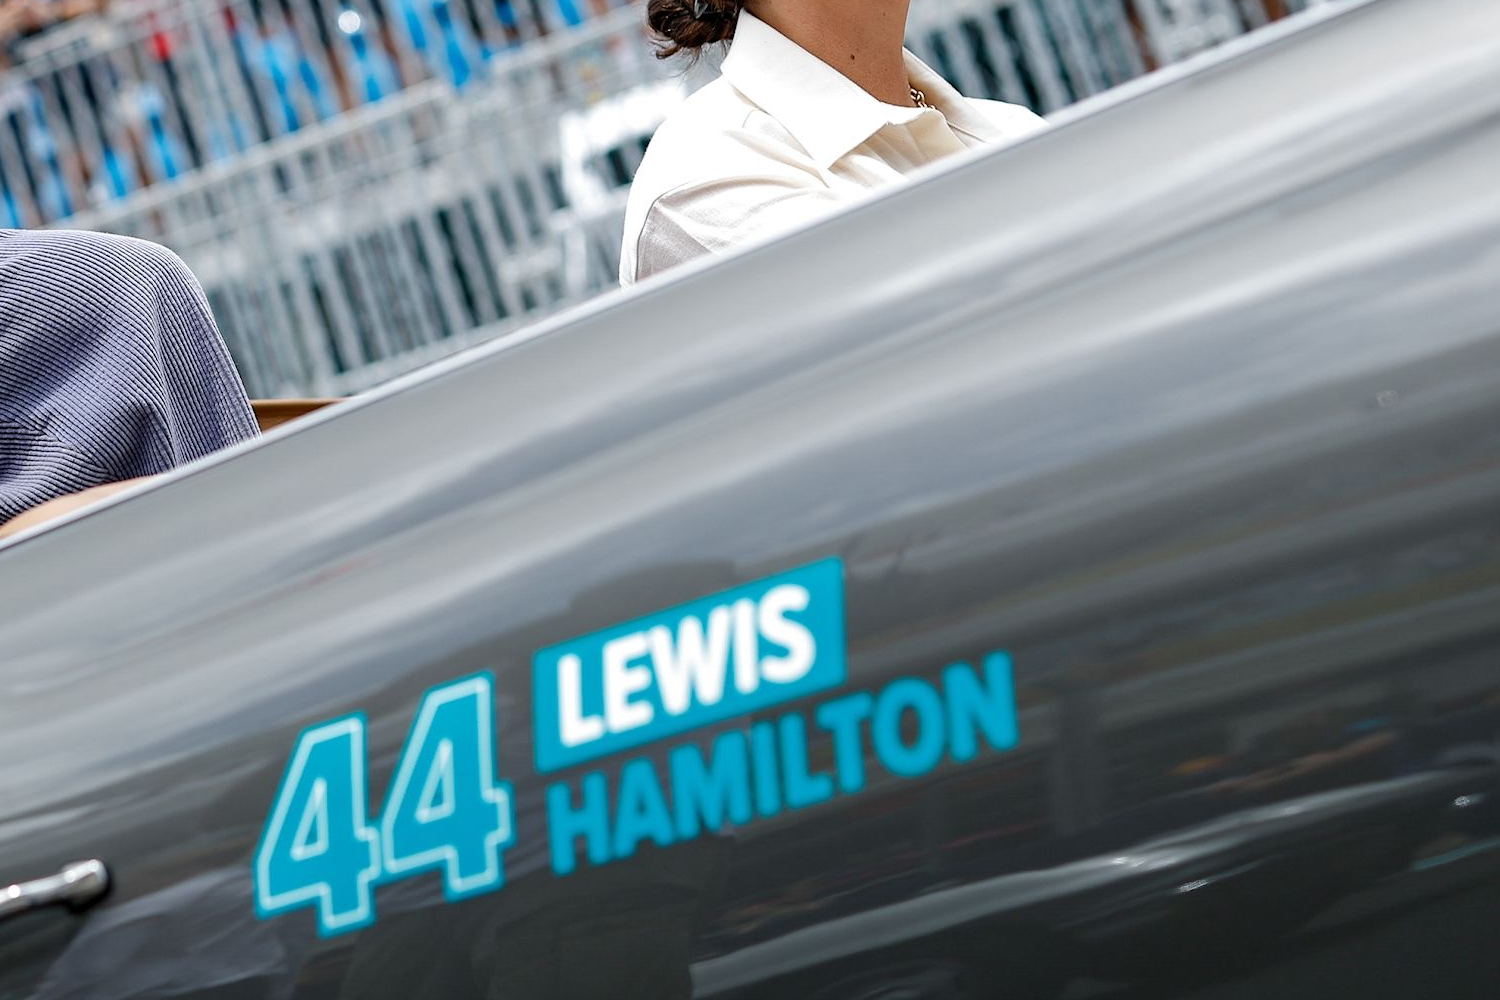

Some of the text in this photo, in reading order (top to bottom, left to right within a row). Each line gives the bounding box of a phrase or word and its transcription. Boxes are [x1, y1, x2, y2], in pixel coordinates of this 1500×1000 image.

[545, 649, 1020, 877] HAMILTON
[557, 583, 817, 748] LEWIS
[253, 668, 515, 938] 44
